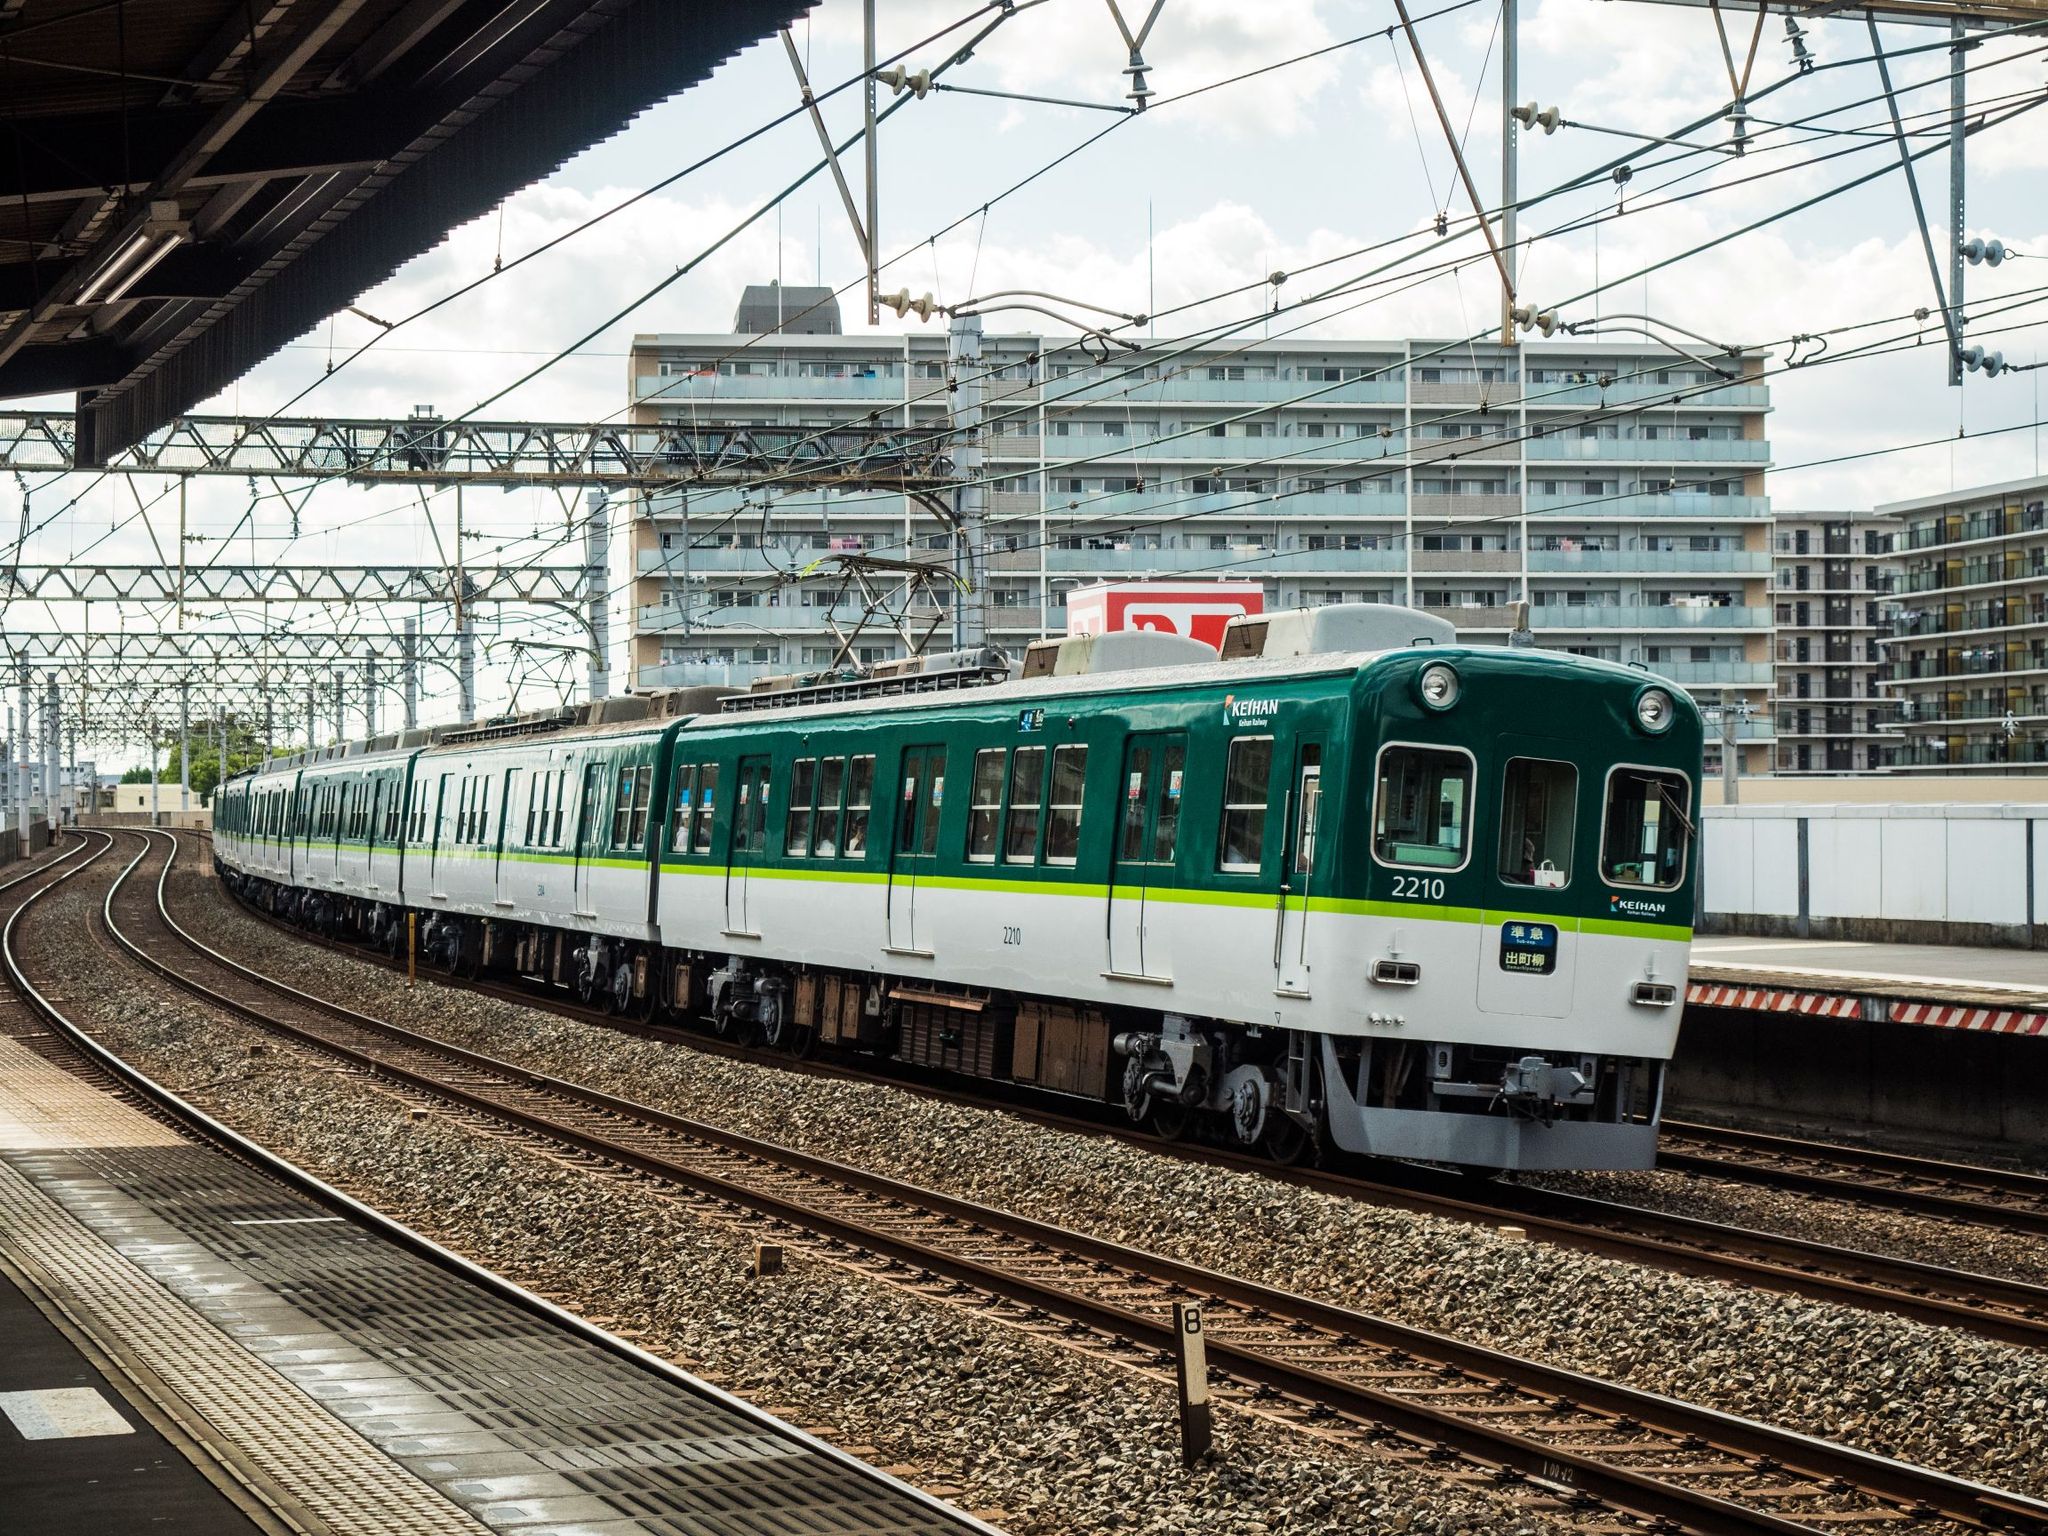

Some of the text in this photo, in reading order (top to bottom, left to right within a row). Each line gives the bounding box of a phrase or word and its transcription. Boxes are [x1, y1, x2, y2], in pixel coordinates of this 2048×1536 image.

[1232, 698, 1279, 717] KEIHAN
[1391, 875, 1445, 900] 2210
[1619, 900, 1666, 913] KEIHAN
[1003, 926, 1021, 946] 2210
[1505, 951, 1545, 967] 出町柳
[1184, 1308, 1201, 1335] 8
